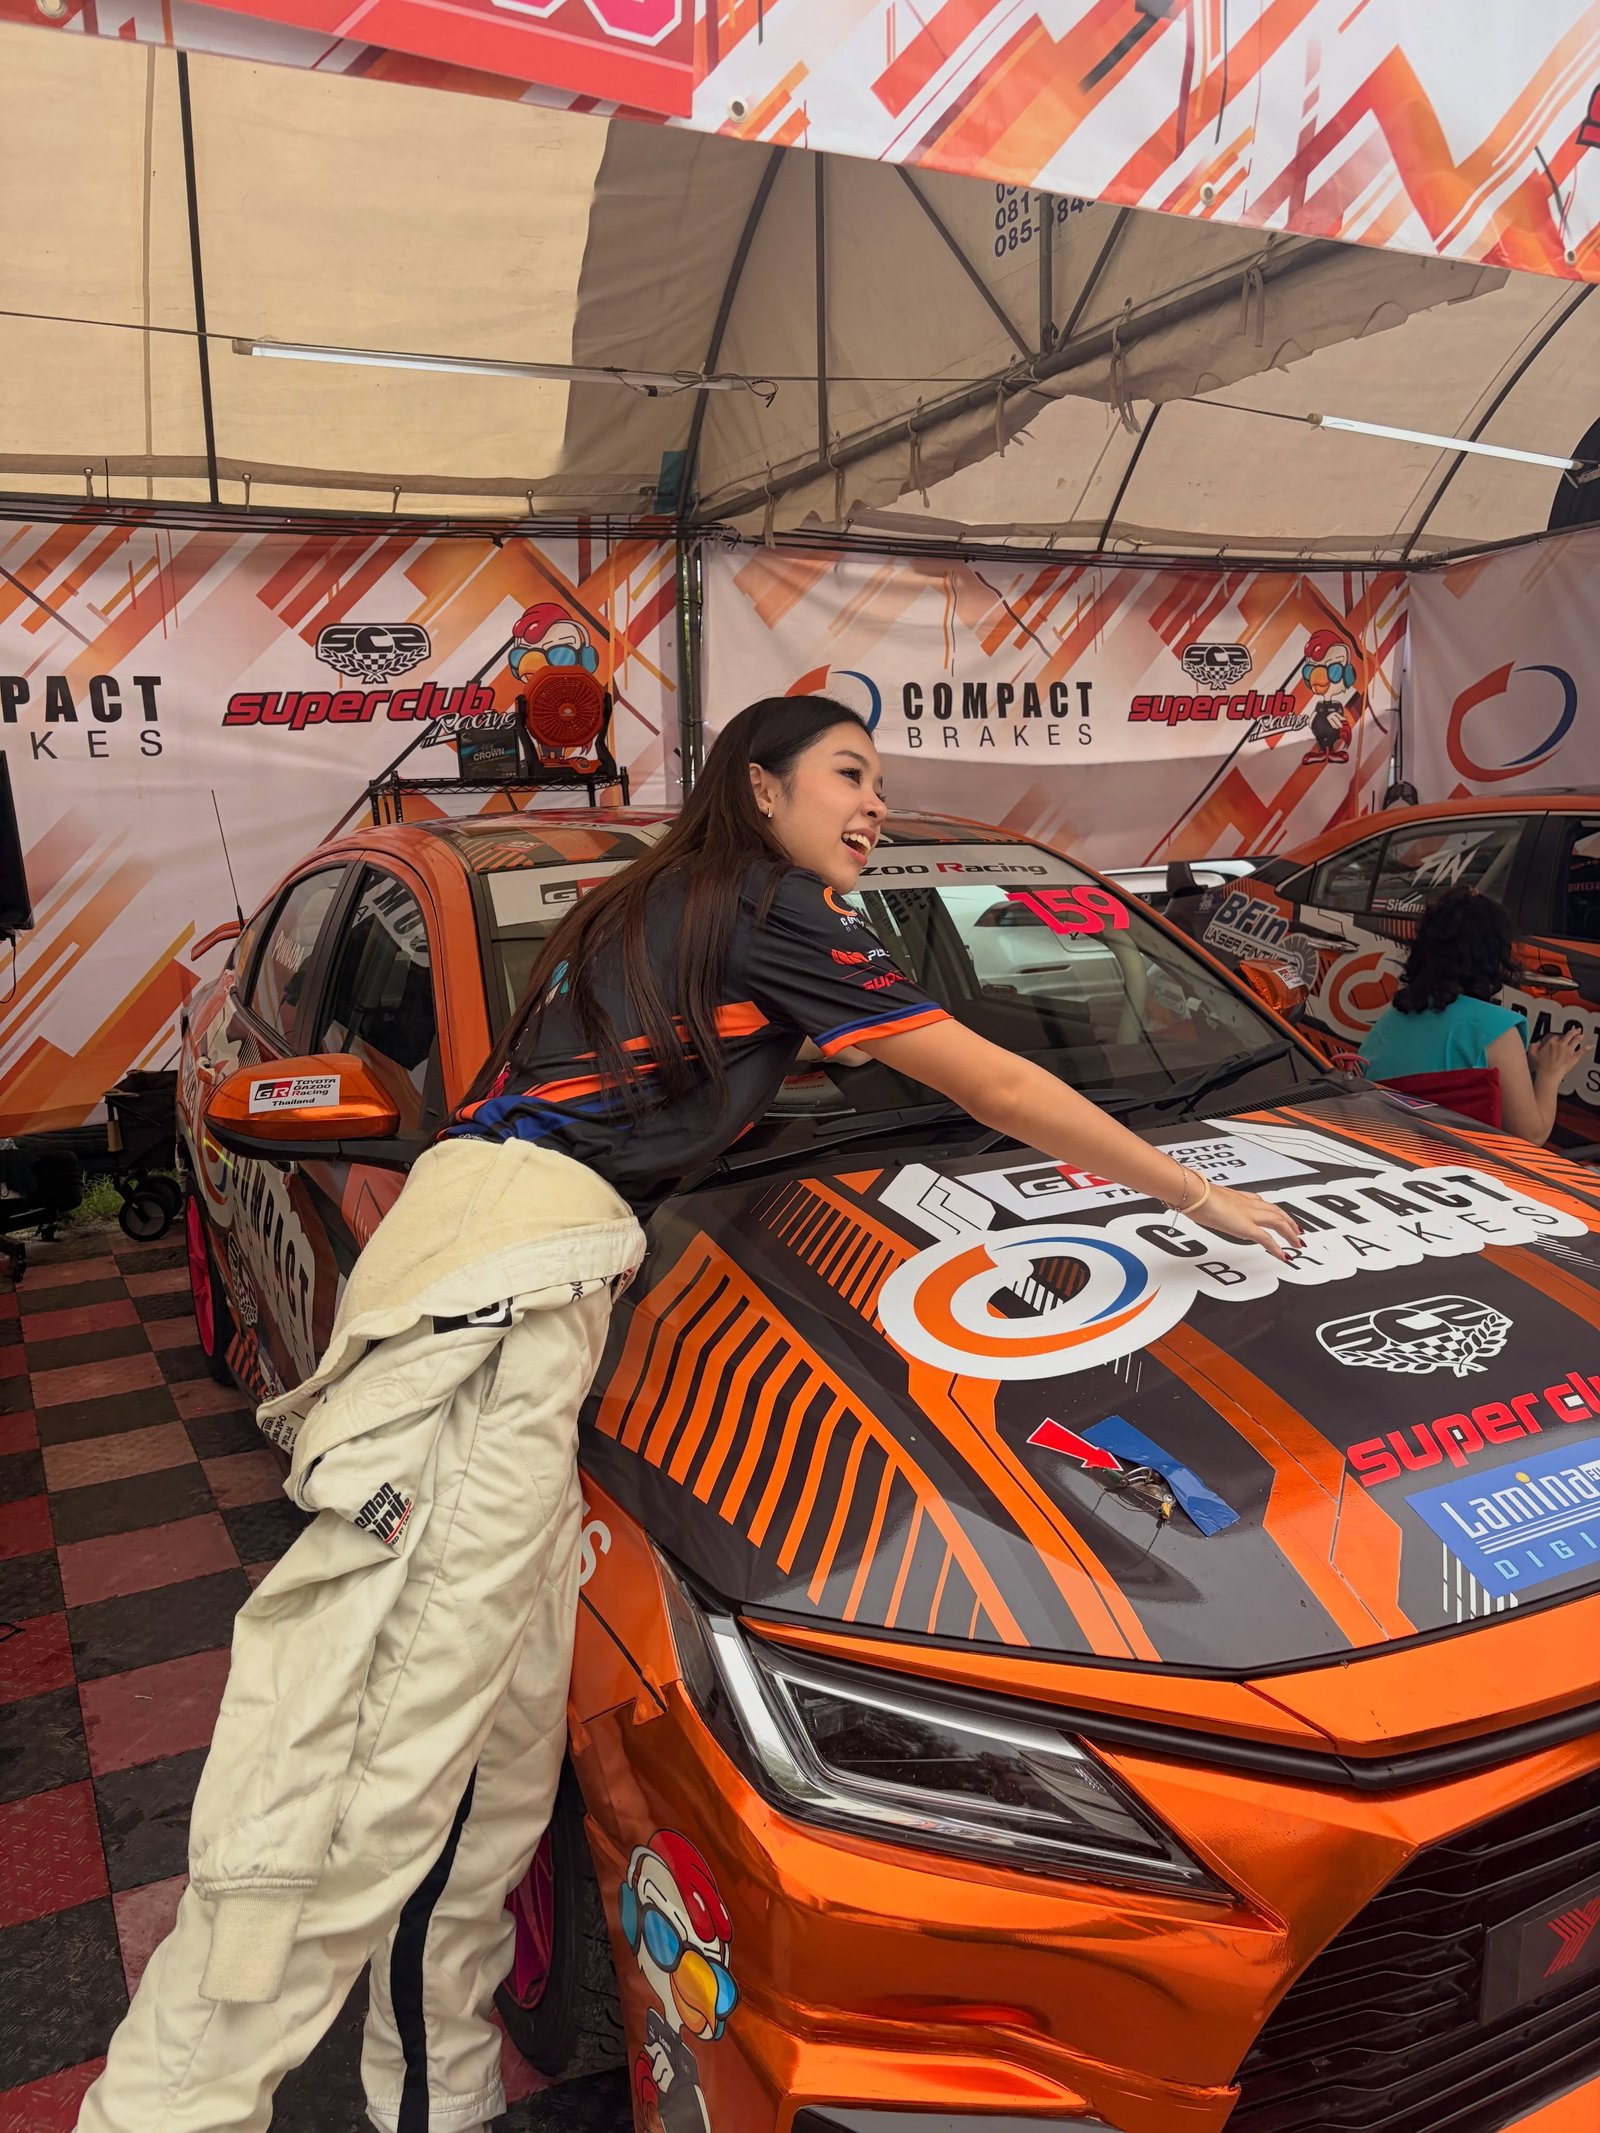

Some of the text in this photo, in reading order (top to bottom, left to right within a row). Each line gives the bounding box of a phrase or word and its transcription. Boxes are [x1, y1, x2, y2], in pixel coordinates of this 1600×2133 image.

[0, 674, 162, 723] PACT
[903, 681, 1093, 720] COMPACT
[30, 729, 163, 760] KES
[907, 723, 1093, 749] BRAKES
[473, 747, 505, 761] CROWN
[935, 862, 1048, 875] Racing
[1004, 886, 1130, 935] 159
[255, 1083, 293, 1101] GR
[272, 1098, 316, 1107] Thailand
[292, 1089, 329, 1097] Racing
[1195, 1206, 1560, 1286] BRAKES
